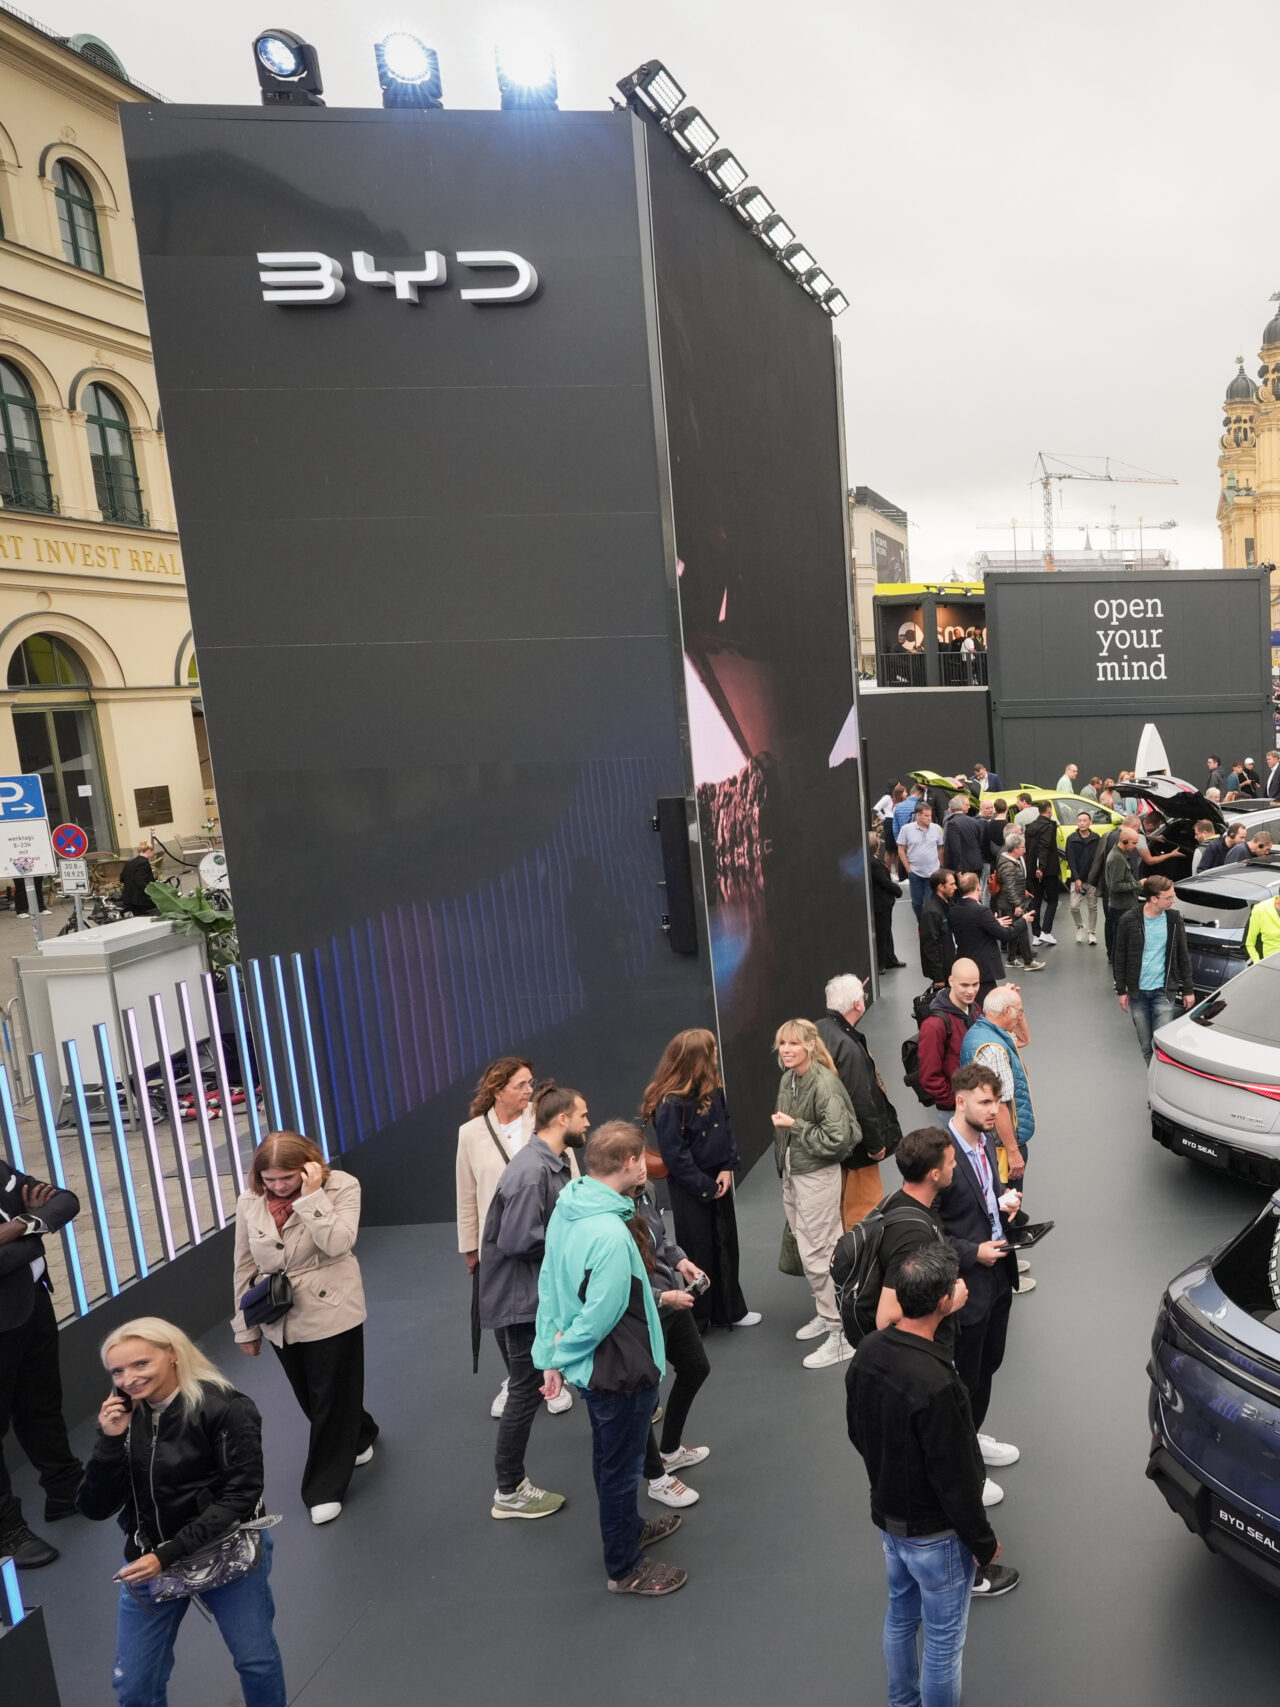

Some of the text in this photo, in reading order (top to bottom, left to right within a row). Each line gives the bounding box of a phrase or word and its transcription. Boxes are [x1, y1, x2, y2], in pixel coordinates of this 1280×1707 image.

[256, 250, 539, 305] BYD
[33, 537, 121, 569] INVEST
[128, 548, 182, 576] REAL
[1093, 598, 1164, 626] open
[1096, 628, 1163, 656] your
[1096, 653, 1168, 681] mind
[0, 781, 24, 816] P
[1182, 1138, 1218, 1157] BYD SEAL
[1219, 1509, 1245, 1531] BYD
